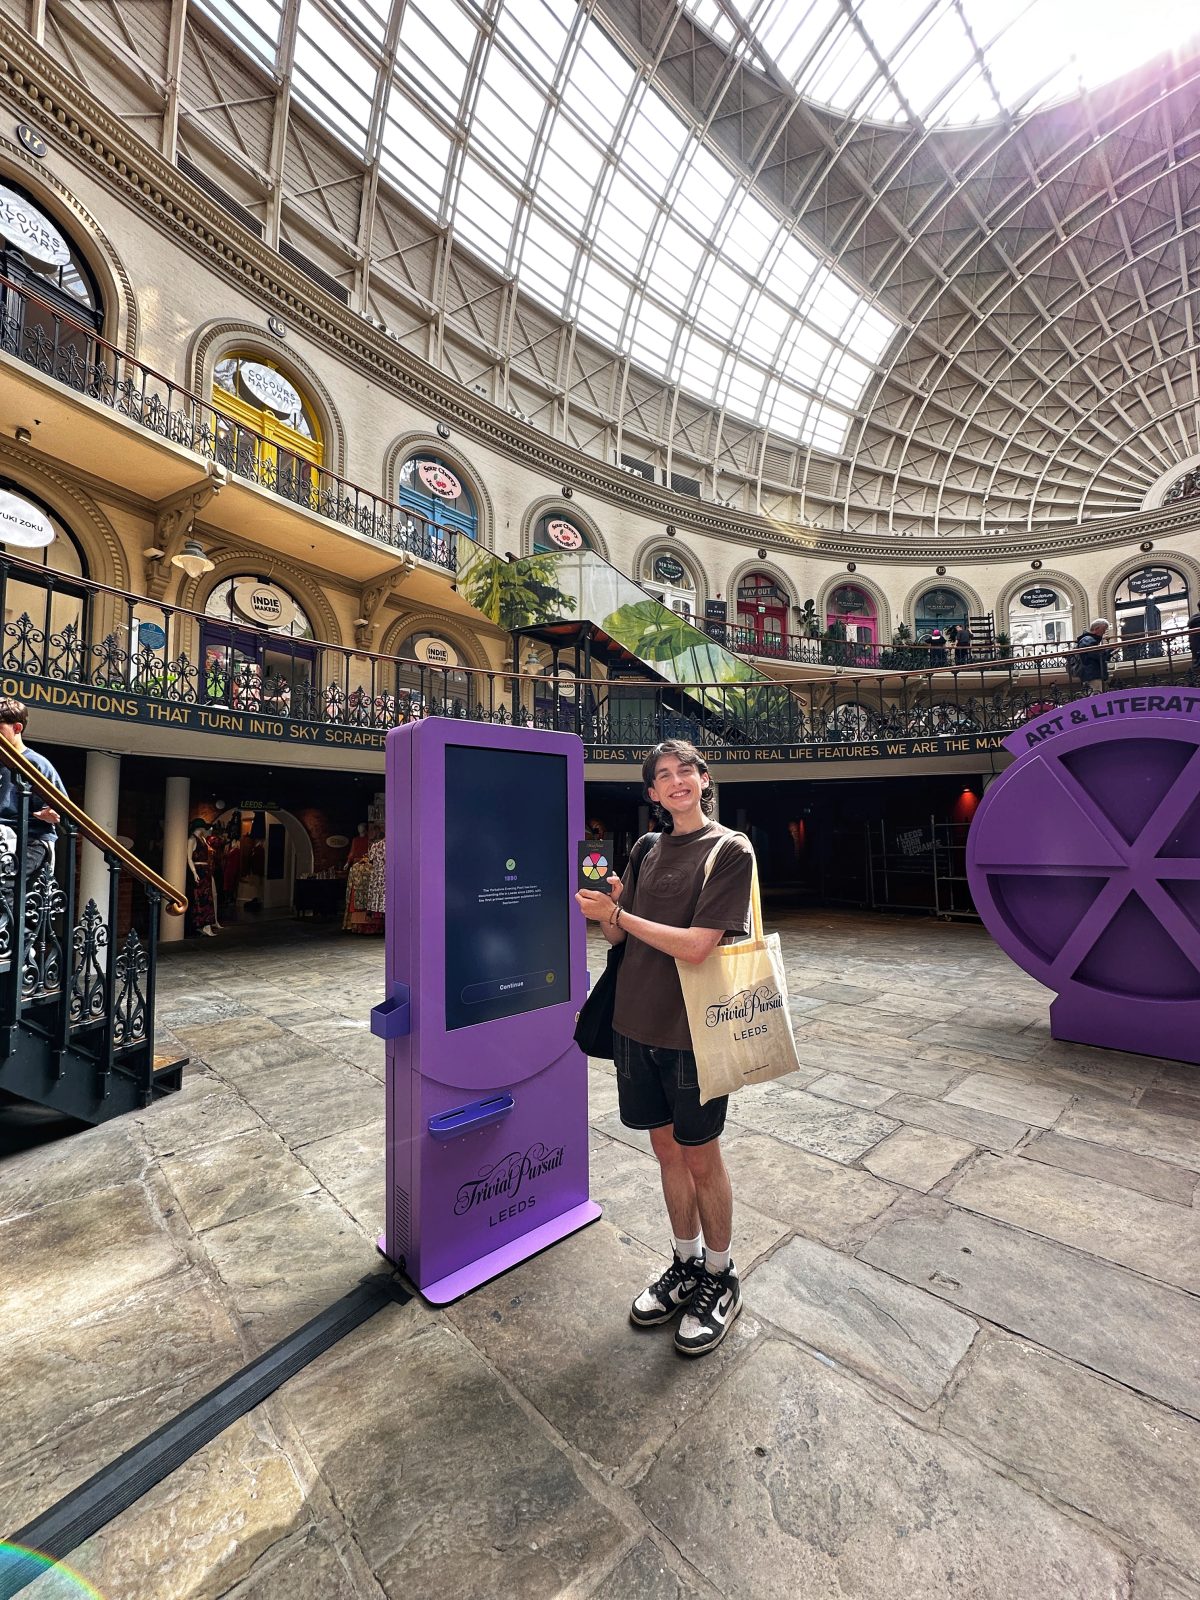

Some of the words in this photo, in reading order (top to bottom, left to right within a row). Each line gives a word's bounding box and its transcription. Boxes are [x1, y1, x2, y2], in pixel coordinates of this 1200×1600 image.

[24, 129, 43, 149] 17
[20, 223, 59, 255] VARY
[248, 369, 296, 401] COLOURS
[248, 376, 268, 392] MAY
[271, 390, 295, 406] VARY
[19, 520, 44, 533] ZOKU
[252, 595, 280, 607] INDIE
[254, 605, 280, 613] MAKERS
[428, 648, 447, 657] INDIE
[146, 703, 191, 724] THAT
[198, 711, 243, 731] TURN
[250, 720, 284, 736] INTO
[290, 725, 319, 740] SKY
[1025, 716, 1064, 748] ART
[1070, 710, 1089, 725] &
[1091, 695, 1200, 719] LITERAT
[632, 749, 650, 759] VIS
[700, 749, 722, 761] NED
[726, 750, 750, 760] INTO
[754, 749, 785, 760] REAL
[789, 748, 813, 759] LIFE
[817, 745, 882, 758] FEATURES.
[886, 743, 907, 755] WE
[911, 741, 938, 754] ARE
[943, 739, 970, 751] THE
[976, 737, 1003, 749] MAK
[903, 839, 943, 856] EXCHANE
[499, 981, 524, 991] Continue
[705, 989, 752, 1028] Trivial
[733, 1024, 768, 1041] LEEDS
[454, 1152, 521, 1216] Trivial
[507, 1142, 565, 1199] Pursuit
[489, 1195, 536, 1228] LEEDS
